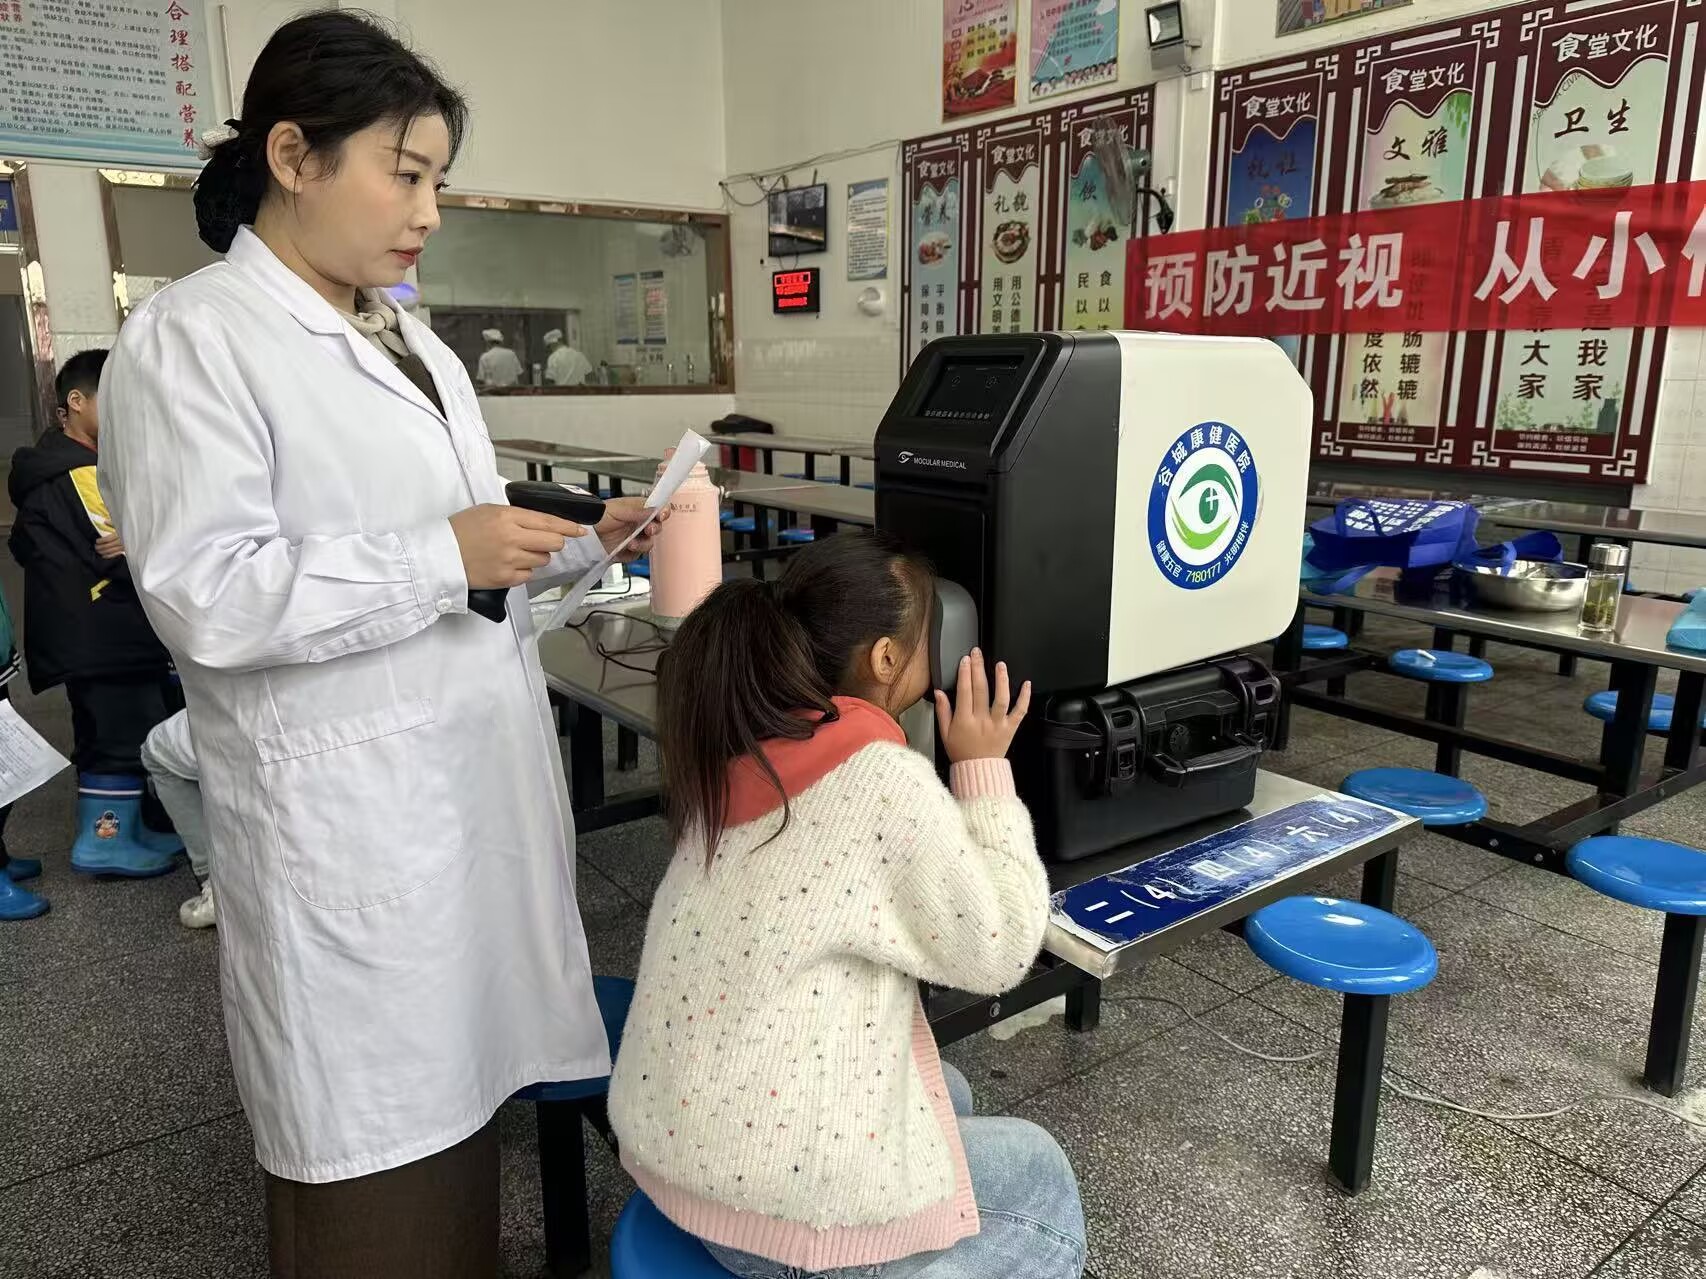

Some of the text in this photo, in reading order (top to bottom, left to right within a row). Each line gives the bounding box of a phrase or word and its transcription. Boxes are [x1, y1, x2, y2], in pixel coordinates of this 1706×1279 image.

[1551, 24, 1658, 62] 食堂文化
[165, 0, 199, 149] 合理搭配营养
[1381, 62, 1465, 94] 食堂文化
[1242, 92, 1312, 119] 食堂文化
[1554, 98, 1631, 138] 卫生
[991, 144, 1035, 165] 食堂文化
[1383, 126, 1449, 160] 文雅
[918, 160, 956, 179] 食堂文化
[994, 191, 1030, 213] 礼貌
[1145, 233, 1404, 320] 预防近视
[1075, 272, 1090, 330] 民以
[914, 457, 967, 469] MOCULAR MEDICAL
[1158, 425, 1251, 487] 谷城康健医院
[1156, 540, 1183, 578] 健康五官
[1185, 561, 1222, 583] 7180177
